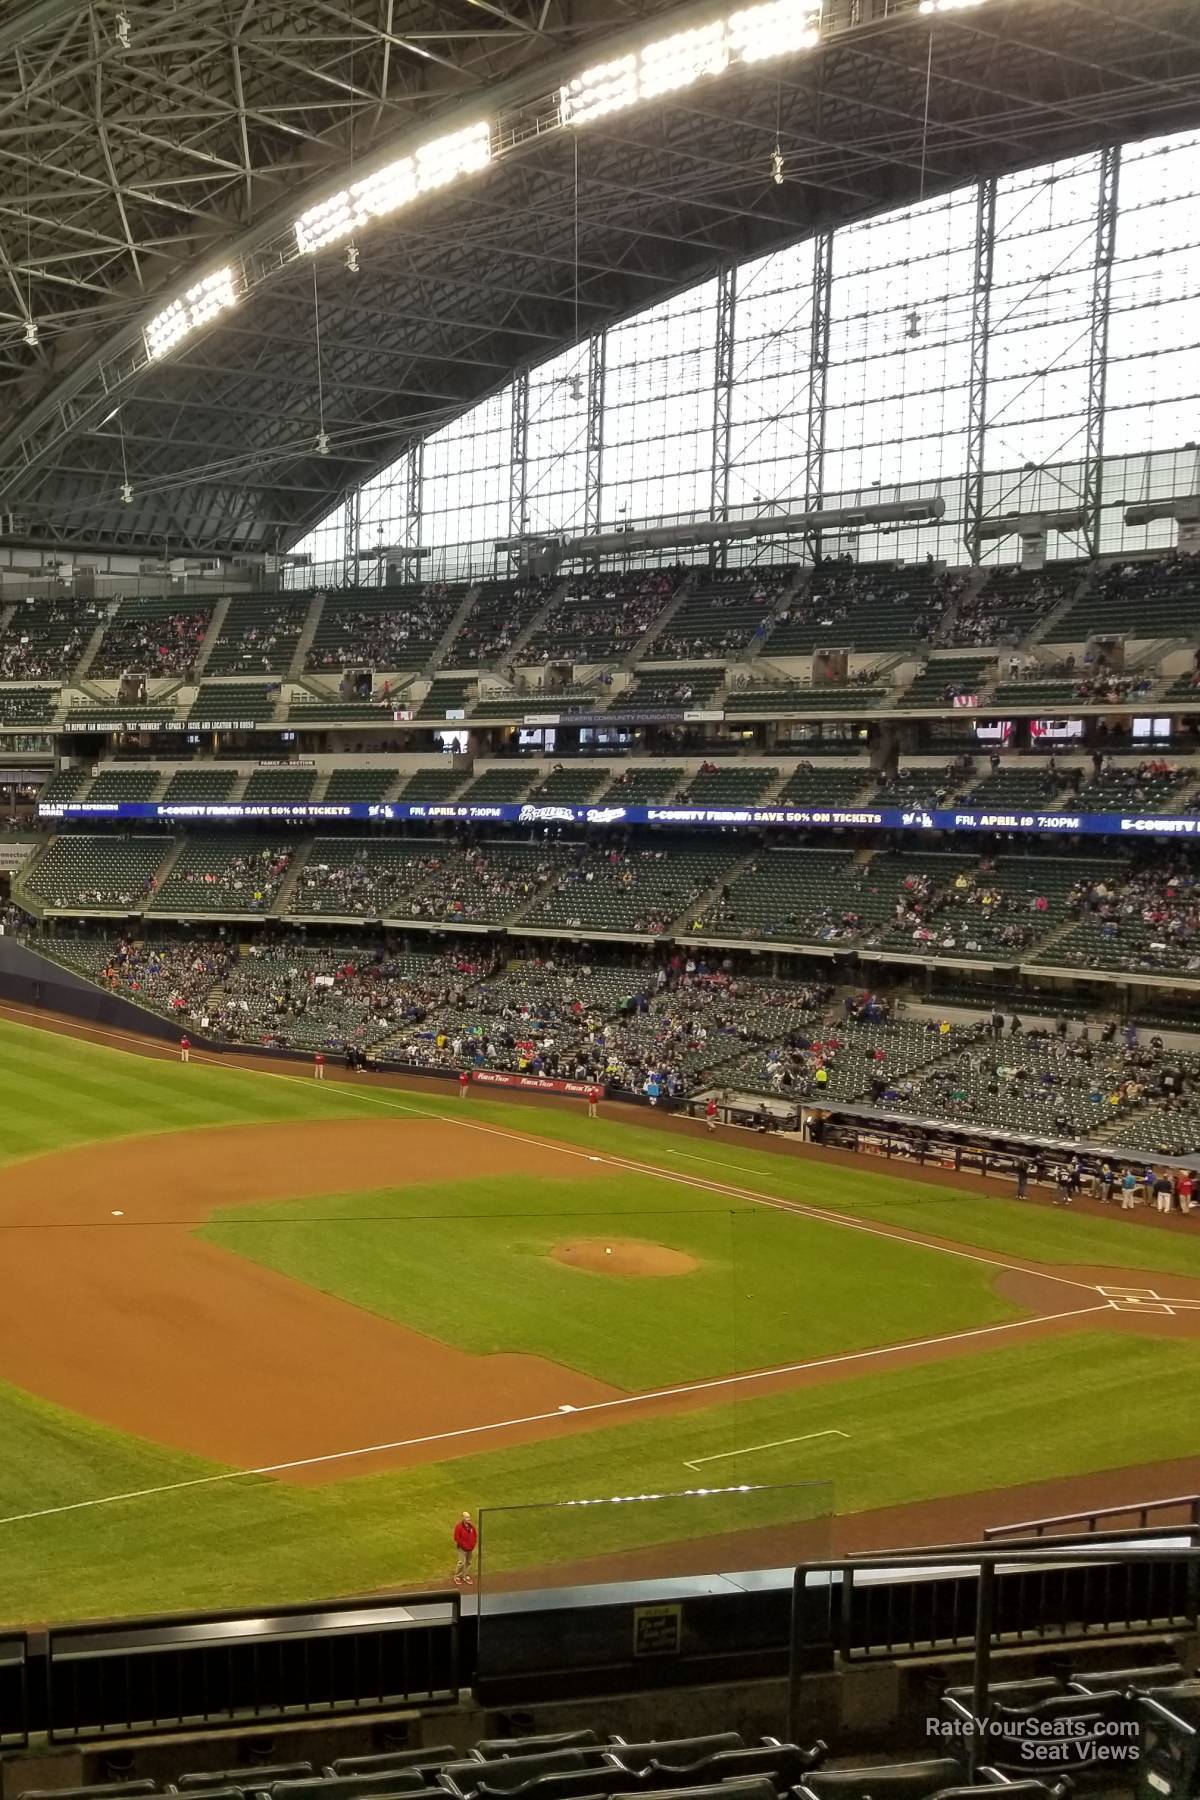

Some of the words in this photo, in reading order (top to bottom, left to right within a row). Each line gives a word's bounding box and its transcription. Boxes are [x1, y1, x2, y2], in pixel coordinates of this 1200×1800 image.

[594, 714, 635, 722] COMMUNITY
[636, 713, 684, 721] FOUNDATION
[309, 807, 350, 816] TICKETS
[428, 806, 456, 816] APRIL
[754, 813, 784, 822] SAVE
[787, 813, 810, 822] 50%
[813, 814, 828, 823] ON
[832, 814, 882, 824] TICKETS
[980, 816, 1018, 826] APRIL
